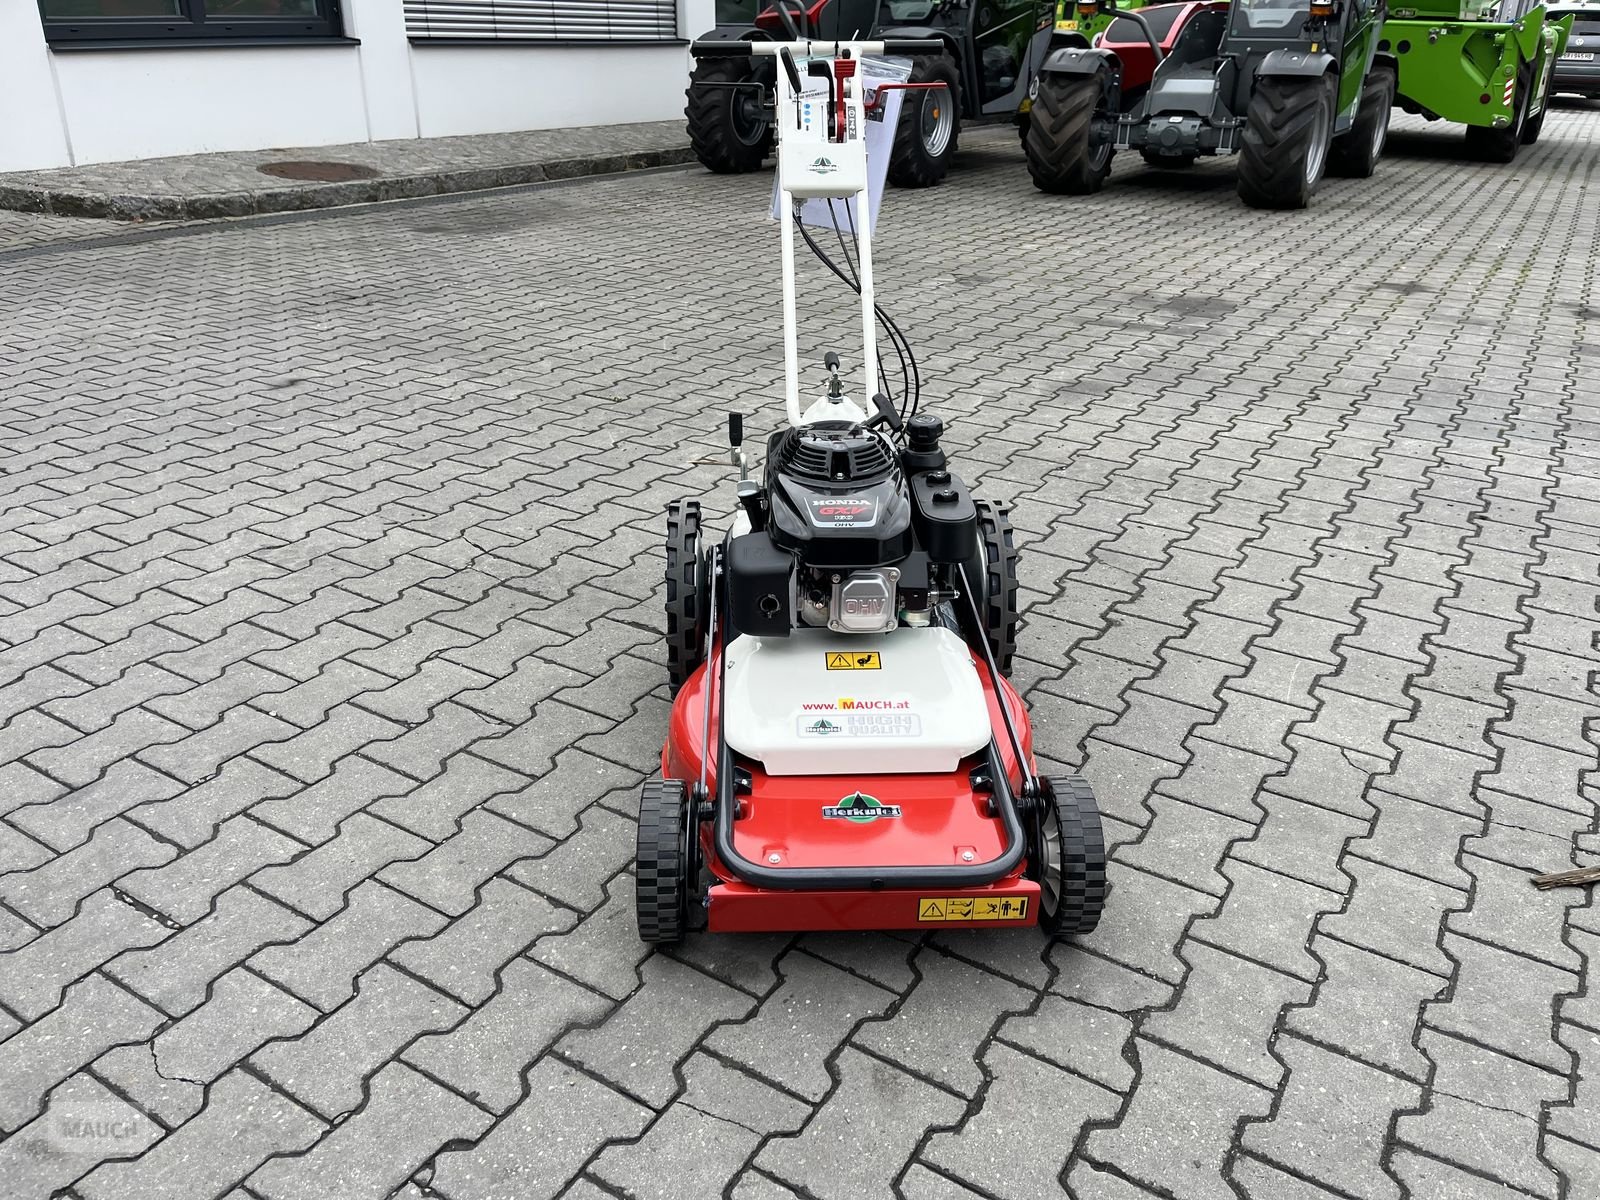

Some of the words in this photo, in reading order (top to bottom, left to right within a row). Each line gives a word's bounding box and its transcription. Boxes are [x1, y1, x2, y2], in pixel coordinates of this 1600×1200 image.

[819, 506, 868, 515] GXV
[845, 598, 886, 615] OHV
[847, 715, 912, 725] HIGH
[848, 725, 913, 735] QUALITY
[824, 806, 901, 817] Herkules
